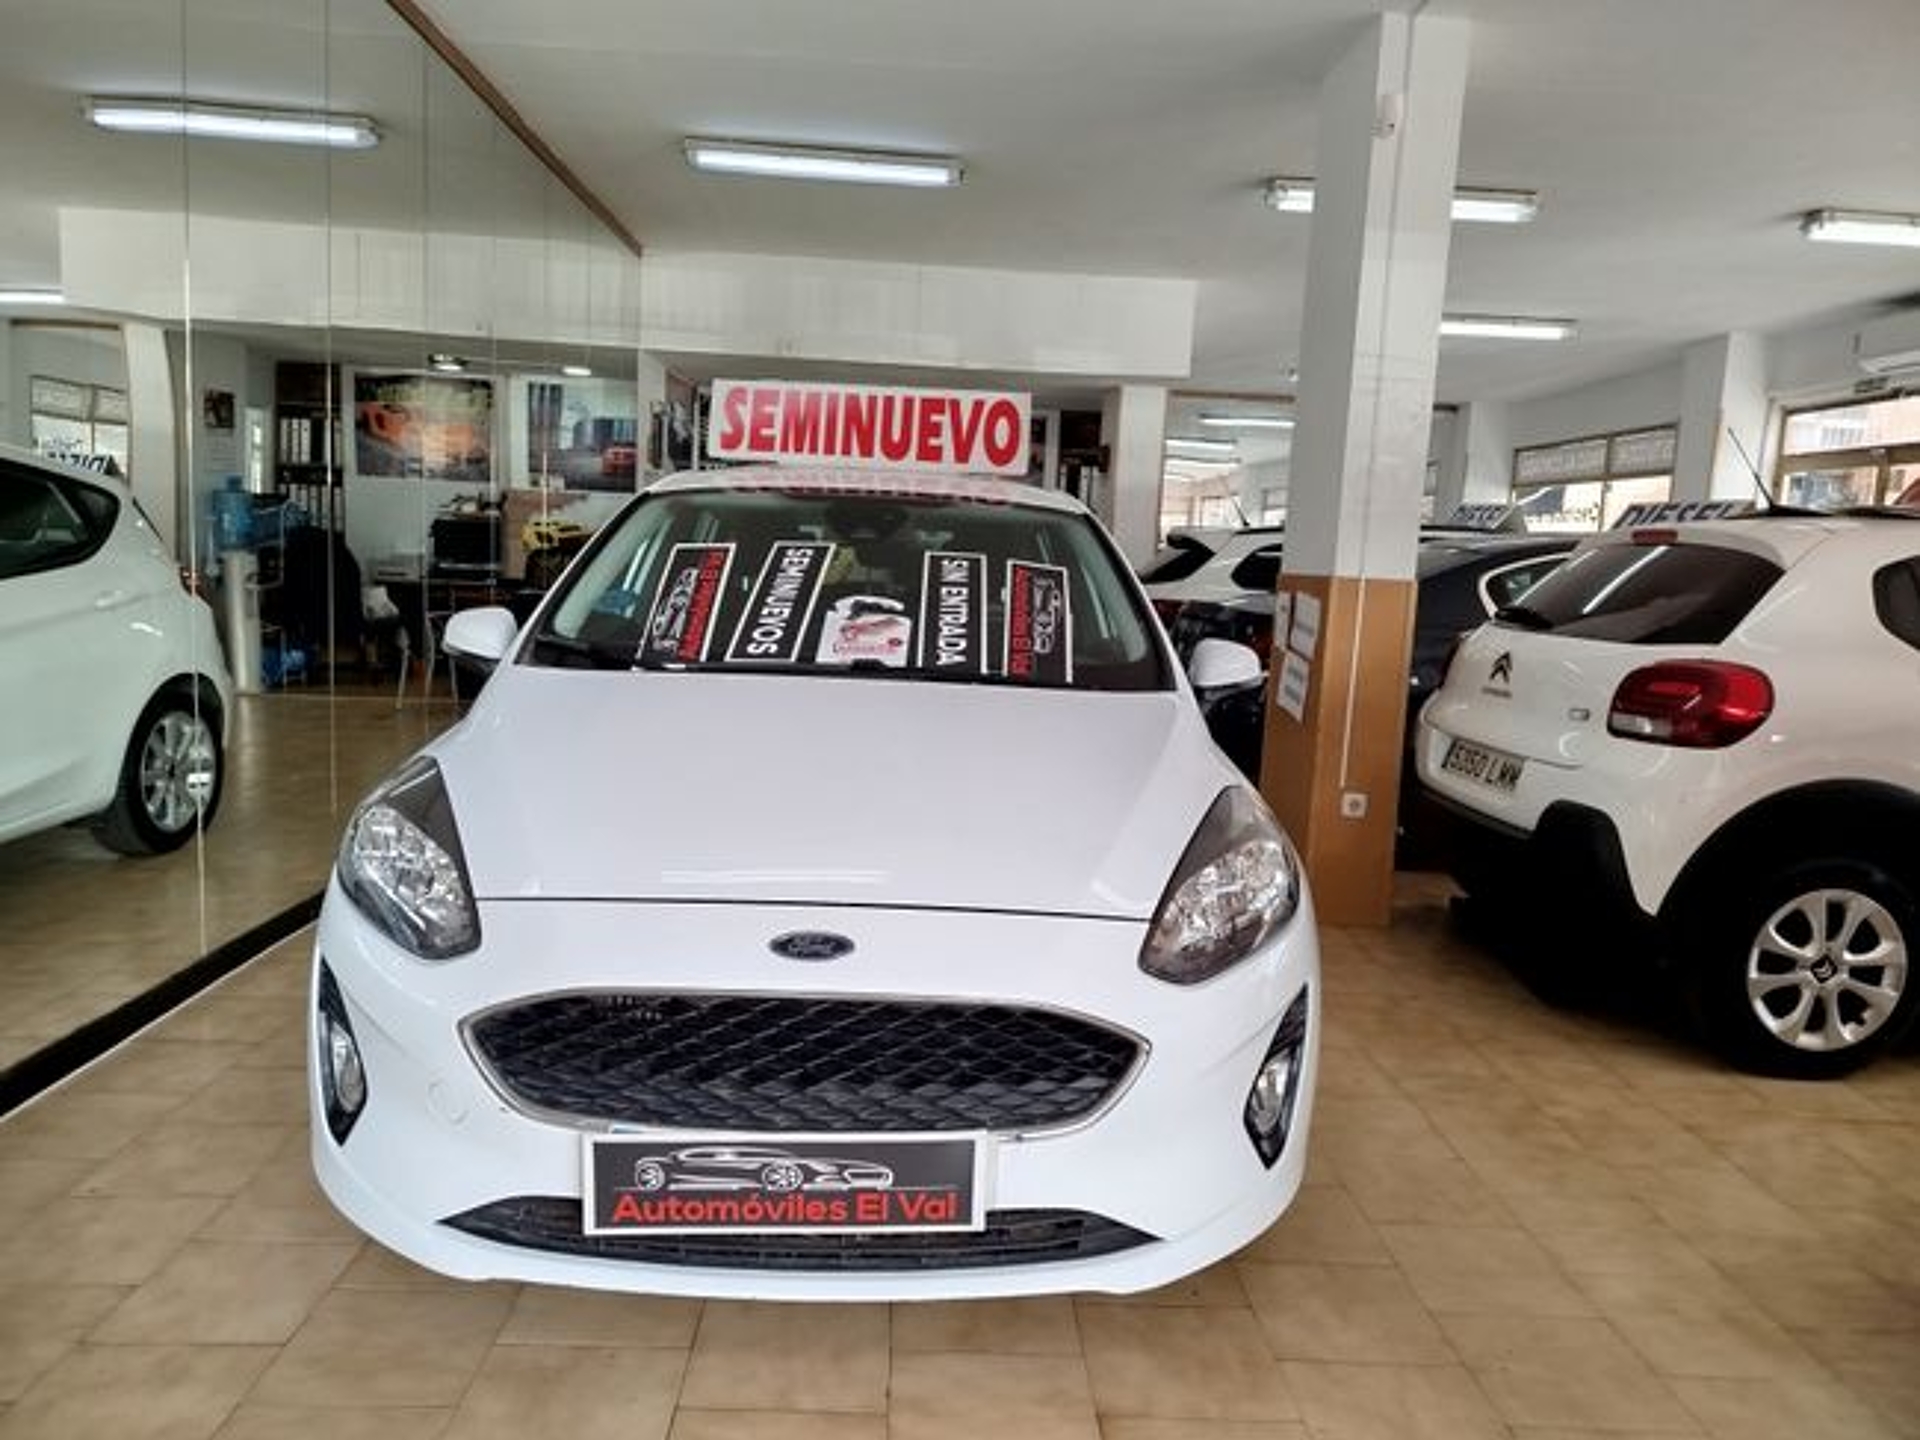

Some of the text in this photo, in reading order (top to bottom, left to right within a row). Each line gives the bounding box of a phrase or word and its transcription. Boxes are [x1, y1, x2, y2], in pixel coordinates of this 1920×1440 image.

[720, 387, 1020, 467] SEMINUEVO
[747, 548, 813, 655] SEMINUEVOS
[936, 559, 970, 666] SIN ENTRADA
[613, 1192, 958, 1223] Automóviles El Val
